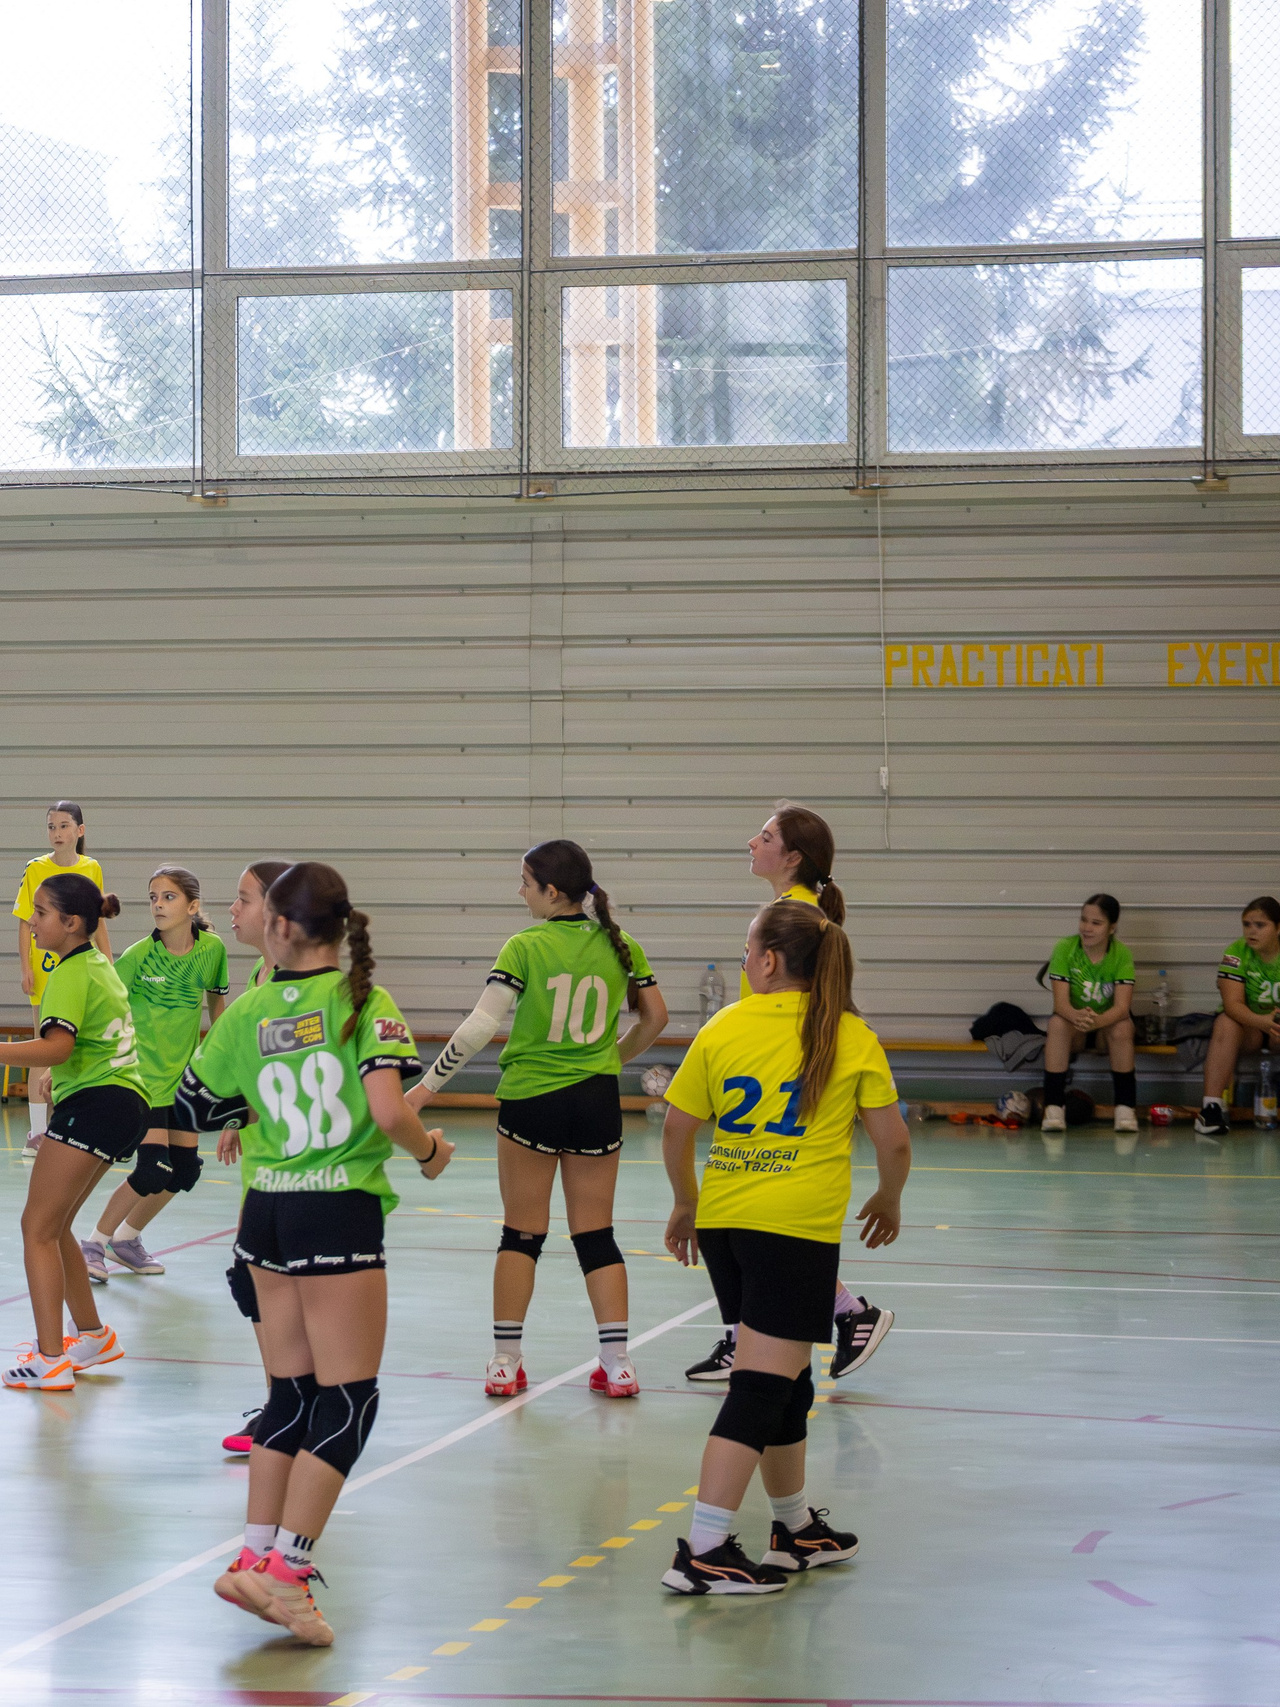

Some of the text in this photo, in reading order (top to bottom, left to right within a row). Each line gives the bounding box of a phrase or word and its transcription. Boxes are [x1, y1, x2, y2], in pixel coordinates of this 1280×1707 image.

[885, 643, 1104, 687] PRACTICATI
[1081, 980, 1104, 1004] 34
[546, 973, 609, 1044] 10
[257, 1050, 352, 1159] 88
[717, 1074, 808, 1137] 21
[67, 1137, 90, 1150] Kempa
[536, 1142, 556, 1154] Kempa
[313, 1254, 346, 1266] Kempa
[351, 1252, 378, 1264] Kempa
